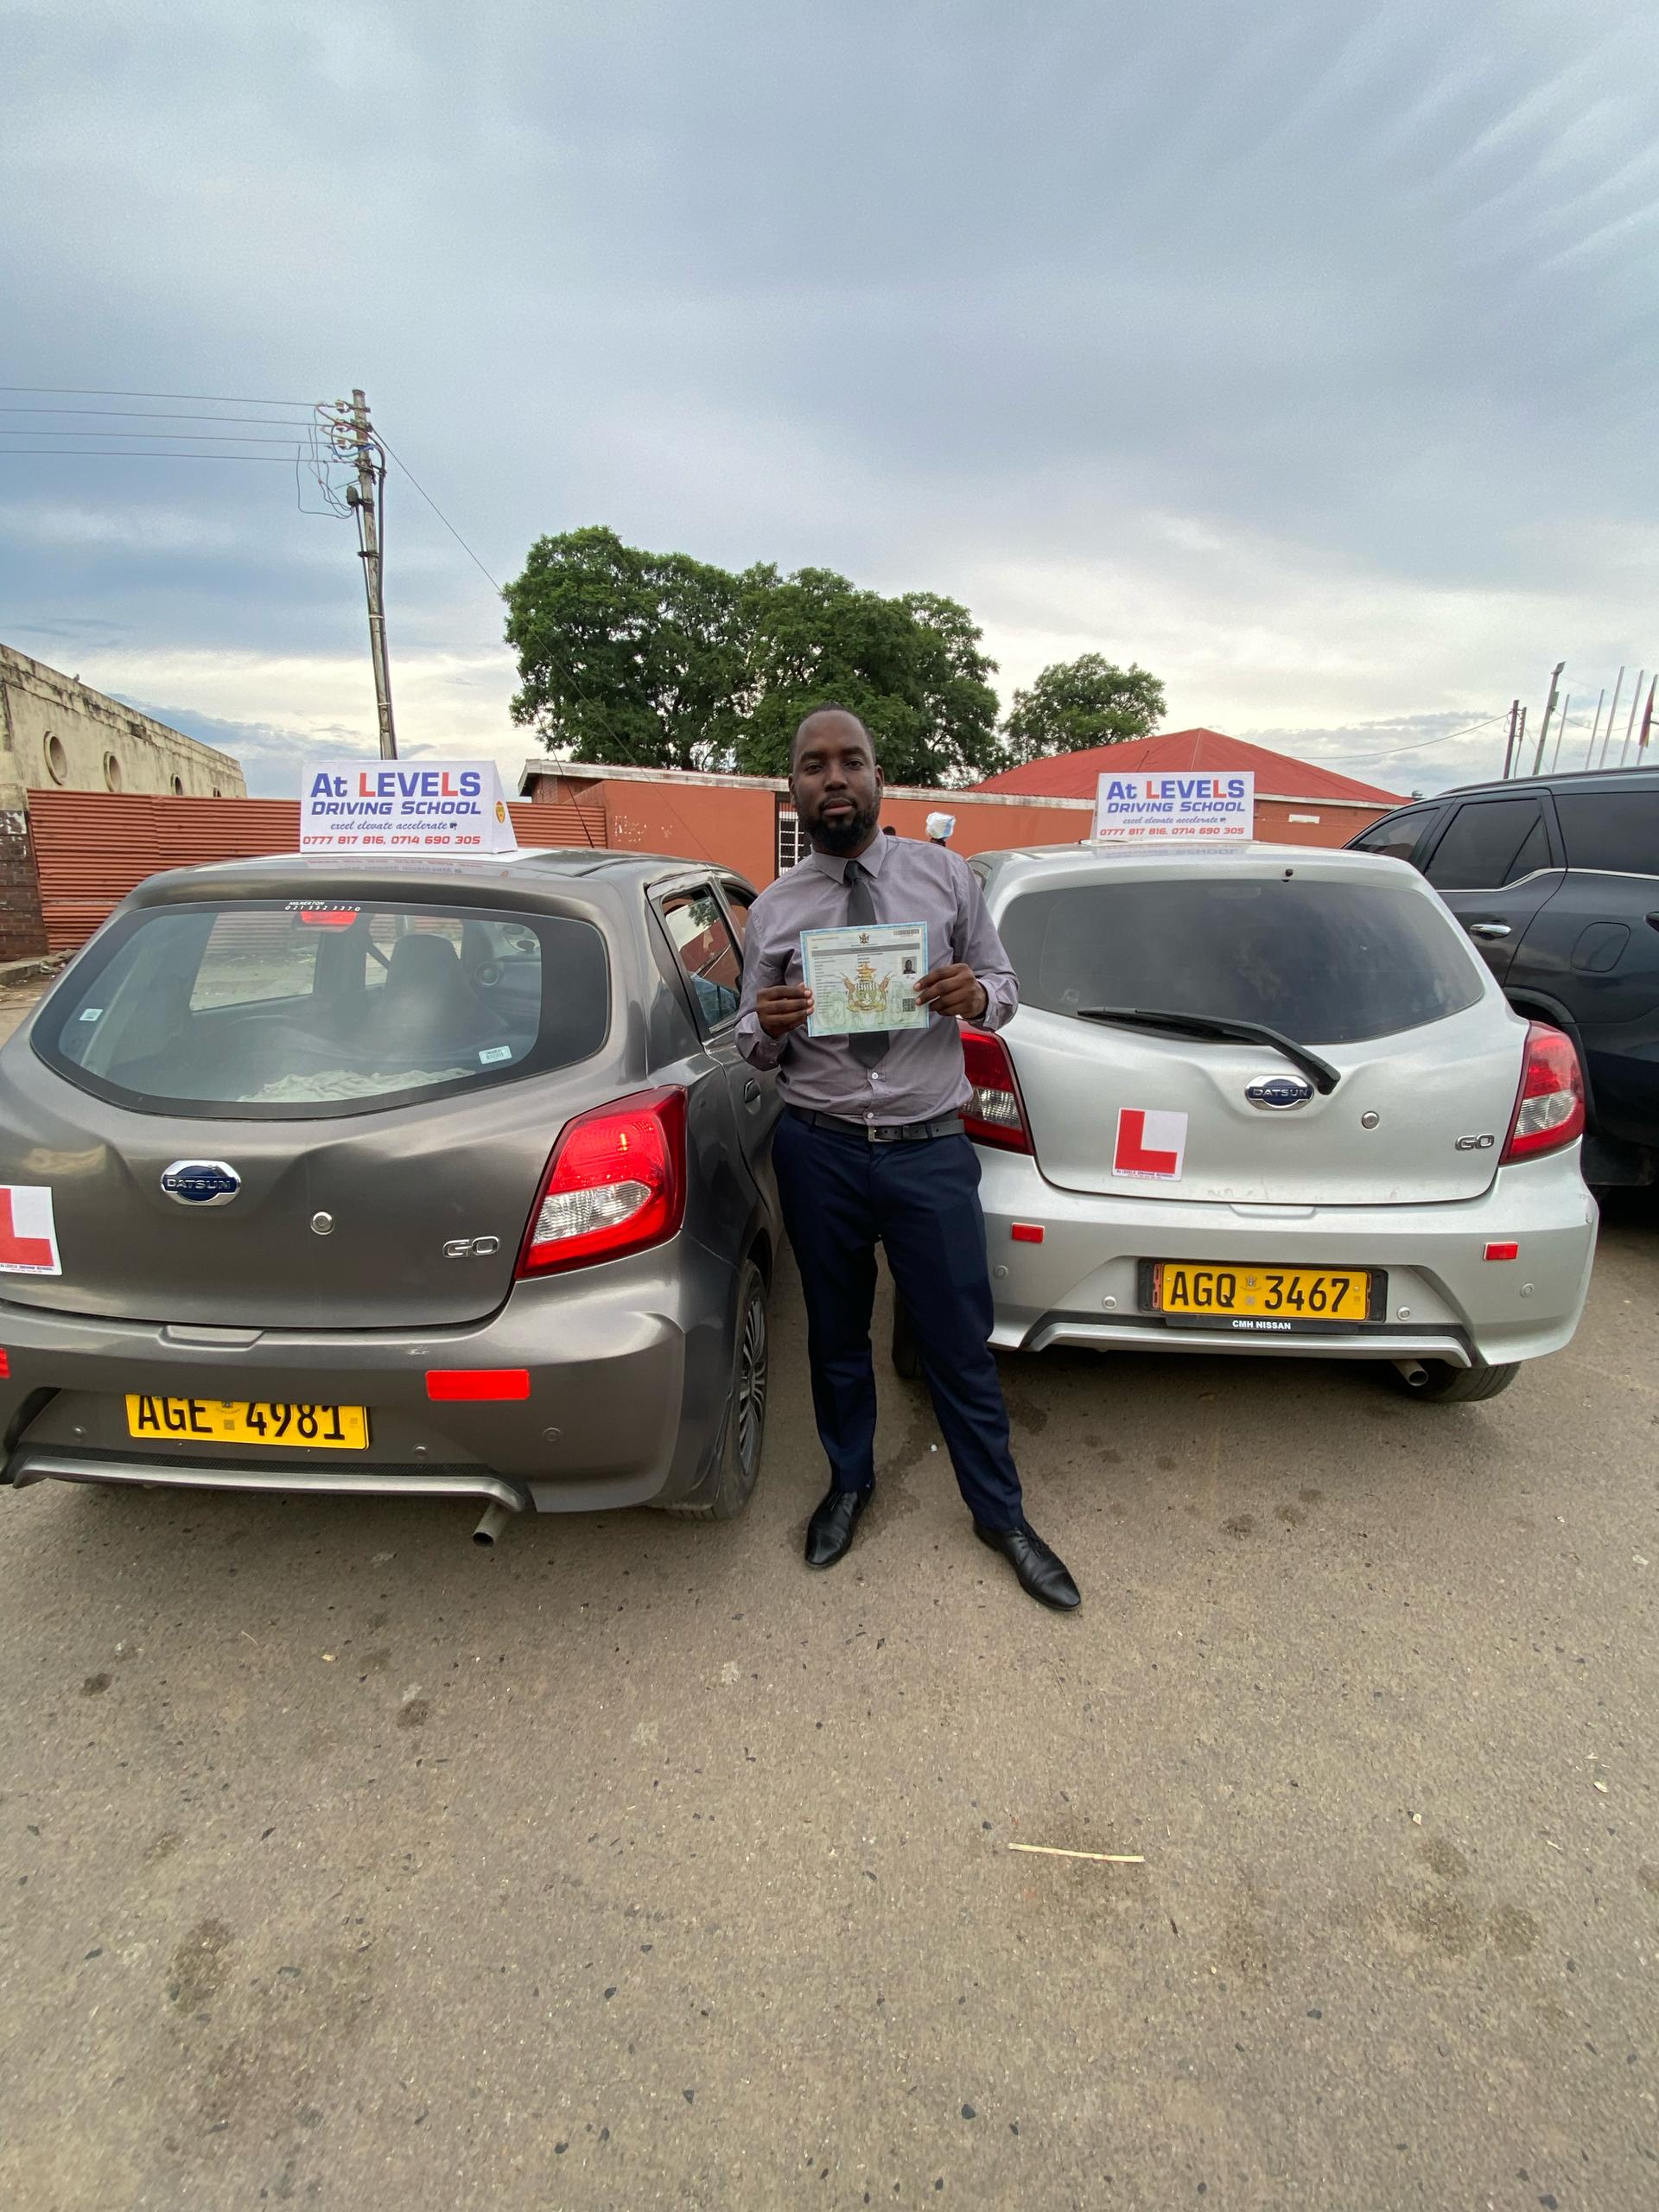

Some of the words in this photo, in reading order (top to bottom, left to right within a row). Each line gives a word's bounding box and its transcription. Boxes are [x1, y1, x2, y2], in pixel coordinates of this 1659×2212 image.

[310, 772, 348, 798] At
[359, 772, 481, 798] LEVELS
[1106, 780, 1138, 800] At
[1146, 779, 1245, 799] LEVELS
[311, 801, 393, 816] DRIVING
[400, 800, 482, 815] SCHOOL
[1107, 802, 1174, 814] DRIVING
[1179, 801, 1246, 812] SCHOOL
[330, 820, 355, 830] excel
[357, 820, 393, 830] elevate
[395, 819, 448, 830] accelerate
[1171, 827, 1196, 836] 0714
[302, 836, 334, 845] 0777
[337, 836, 359, 845] 817
[391, 836, 420, 845] 0714
[424, 836, 451, 845] 690
[454, 836, 481, 845] 305
[1115, 1109, 1177, 1174] L
[1455, 1133, 1495, 1151] GO
[167, 1179, 231, 1190] DATSUN
[0, 1188, 54, 1267] L
[442, 1236, 499, 1259] GO
[1170, 1271, 1236, 1308] AGQ
[1264, 1275, 1351, 1313] 3467
[1232, 1320, 1254, 1329] CMH
[1255, 1321, 1292, 1330] NISSAN
[137, 1395, 213, 1433] AGE
[246, 1402, 346, 1440] 4981
